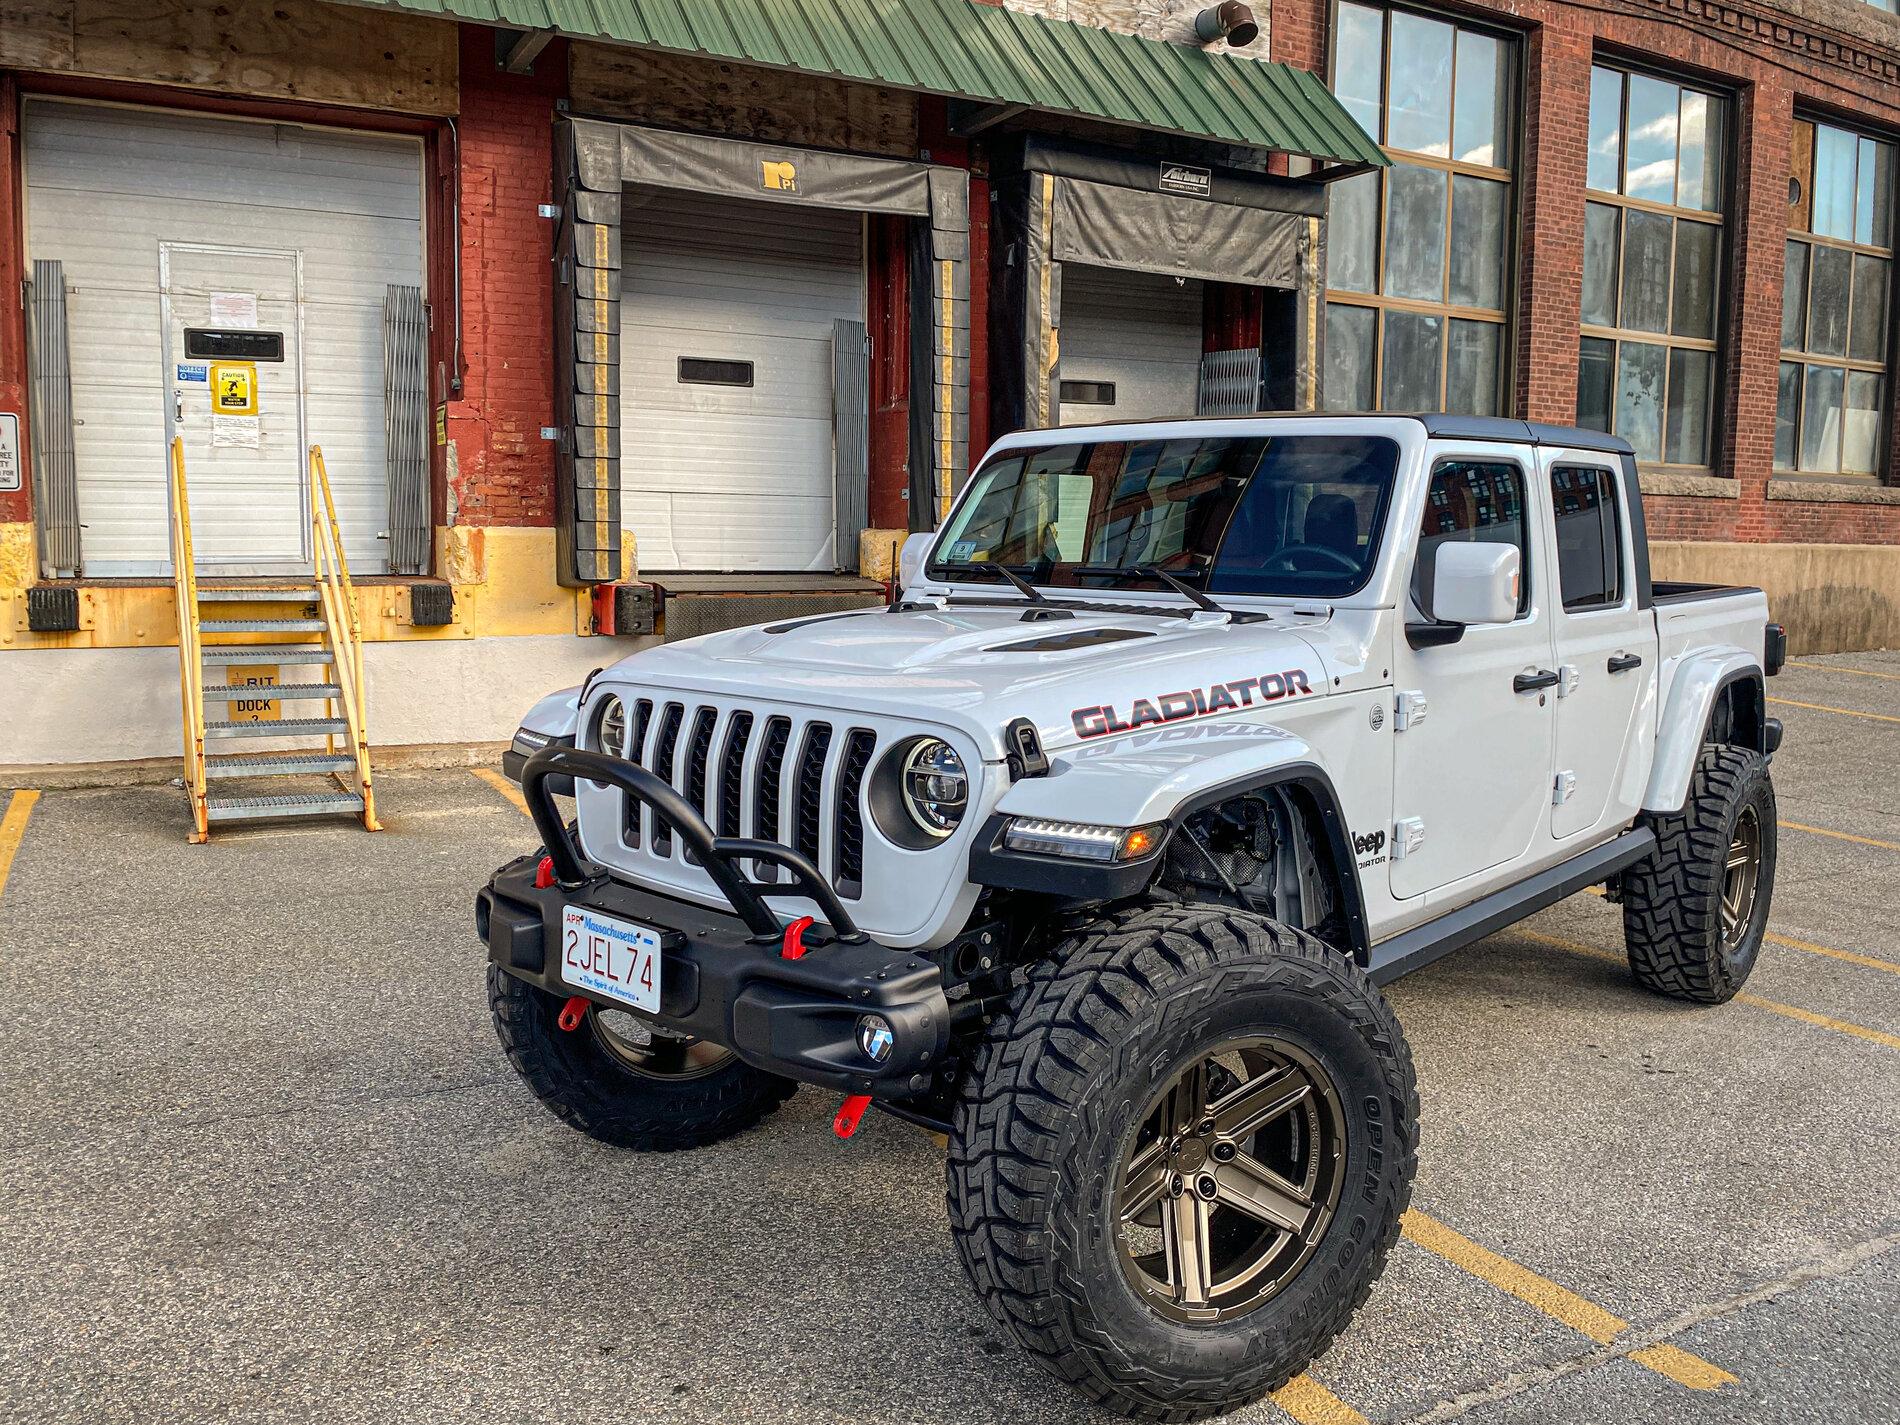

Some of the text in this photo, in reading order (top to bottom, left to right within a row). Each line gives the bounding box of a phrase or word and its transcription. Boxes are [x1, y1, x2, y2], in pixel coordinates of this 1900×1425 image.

[179, 365, 205, 373] NOTICE
[237, 699, 271, 711] DOCK
[1071, 668, 1313, 739] GLADIATOR
[1351, 830, 1385, 855] Jeep
[1358, 856, 1386, 869] DIATOR
[566, 913, 581, 926] APR
[584, 916, 639, 945] Massachusetts
[567, 929, 652, 992] 2JEL 74
[583, 975, 593, 986] The
[594, 979, 607, 989] Spirit
[614, 986, 636, 1000] America
[1362, 1095, 1384, 1205] OPEN
